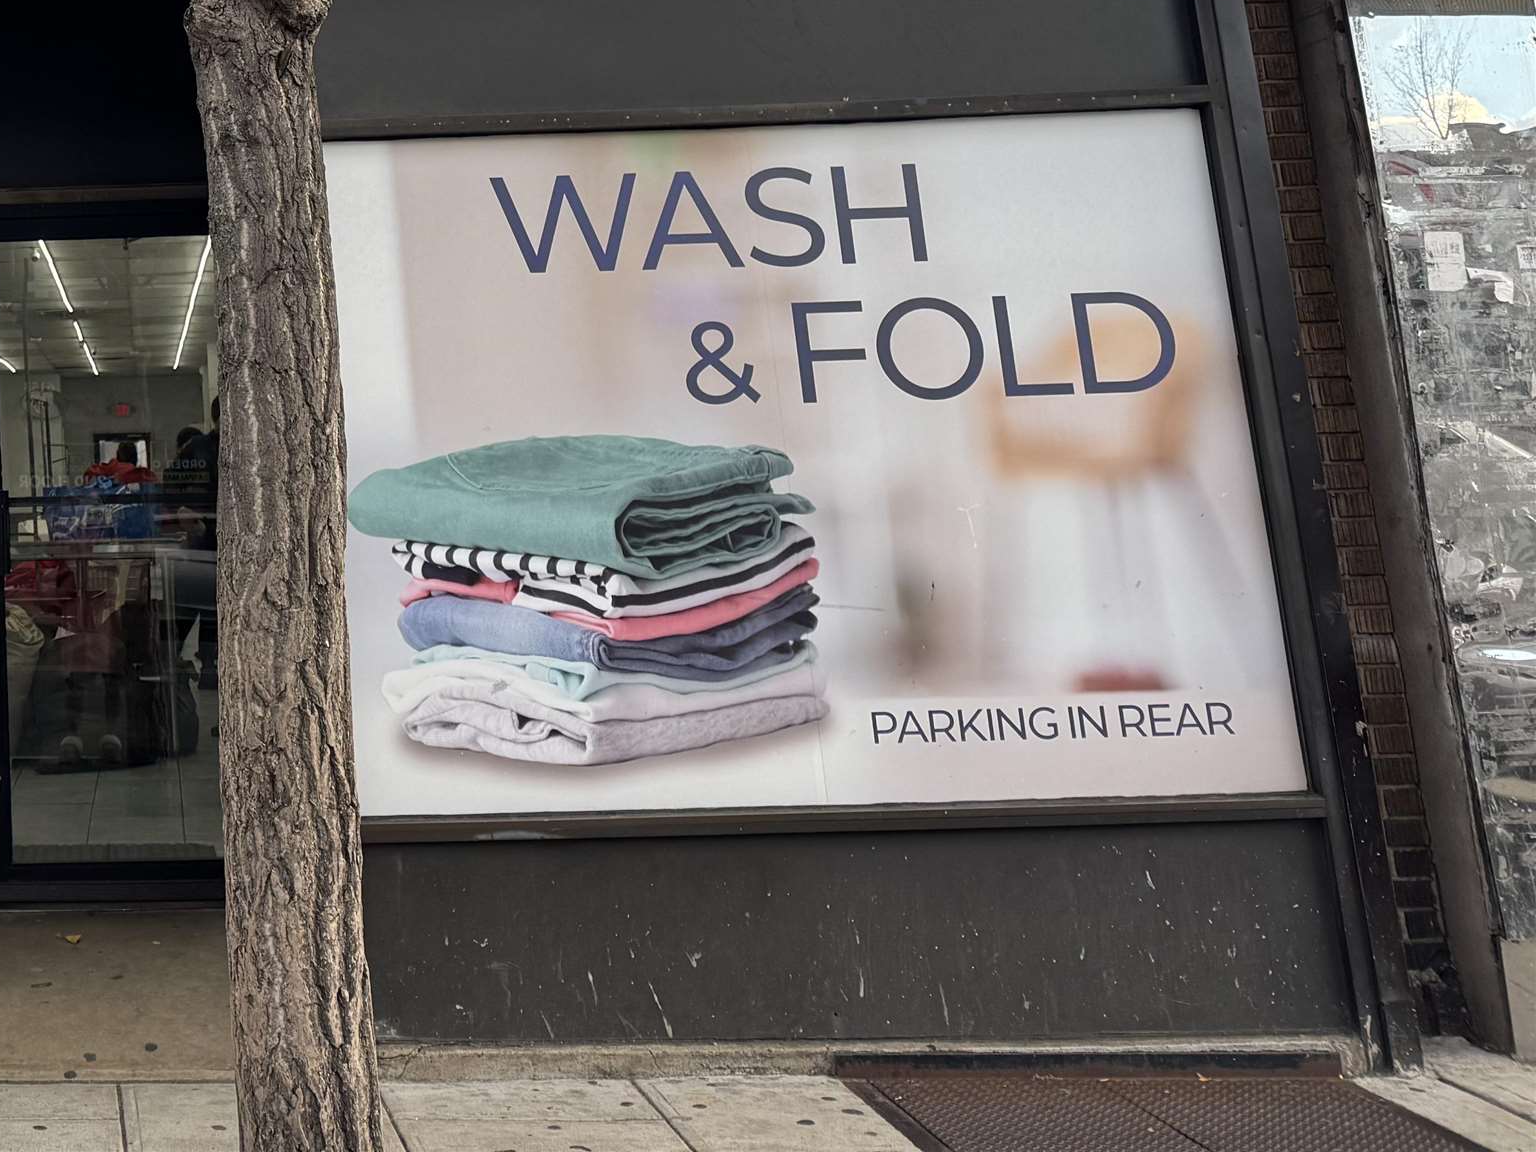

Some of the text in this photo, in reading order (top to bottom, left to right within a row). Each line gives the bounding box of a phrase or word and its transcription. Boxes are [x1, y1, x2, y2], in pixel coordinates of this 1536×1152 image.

[489, 163, 929, 274] WASH
[685, 291, 1177, 405] & FOLD
[871, 701, 1237, 746] PARKING IN REAR
